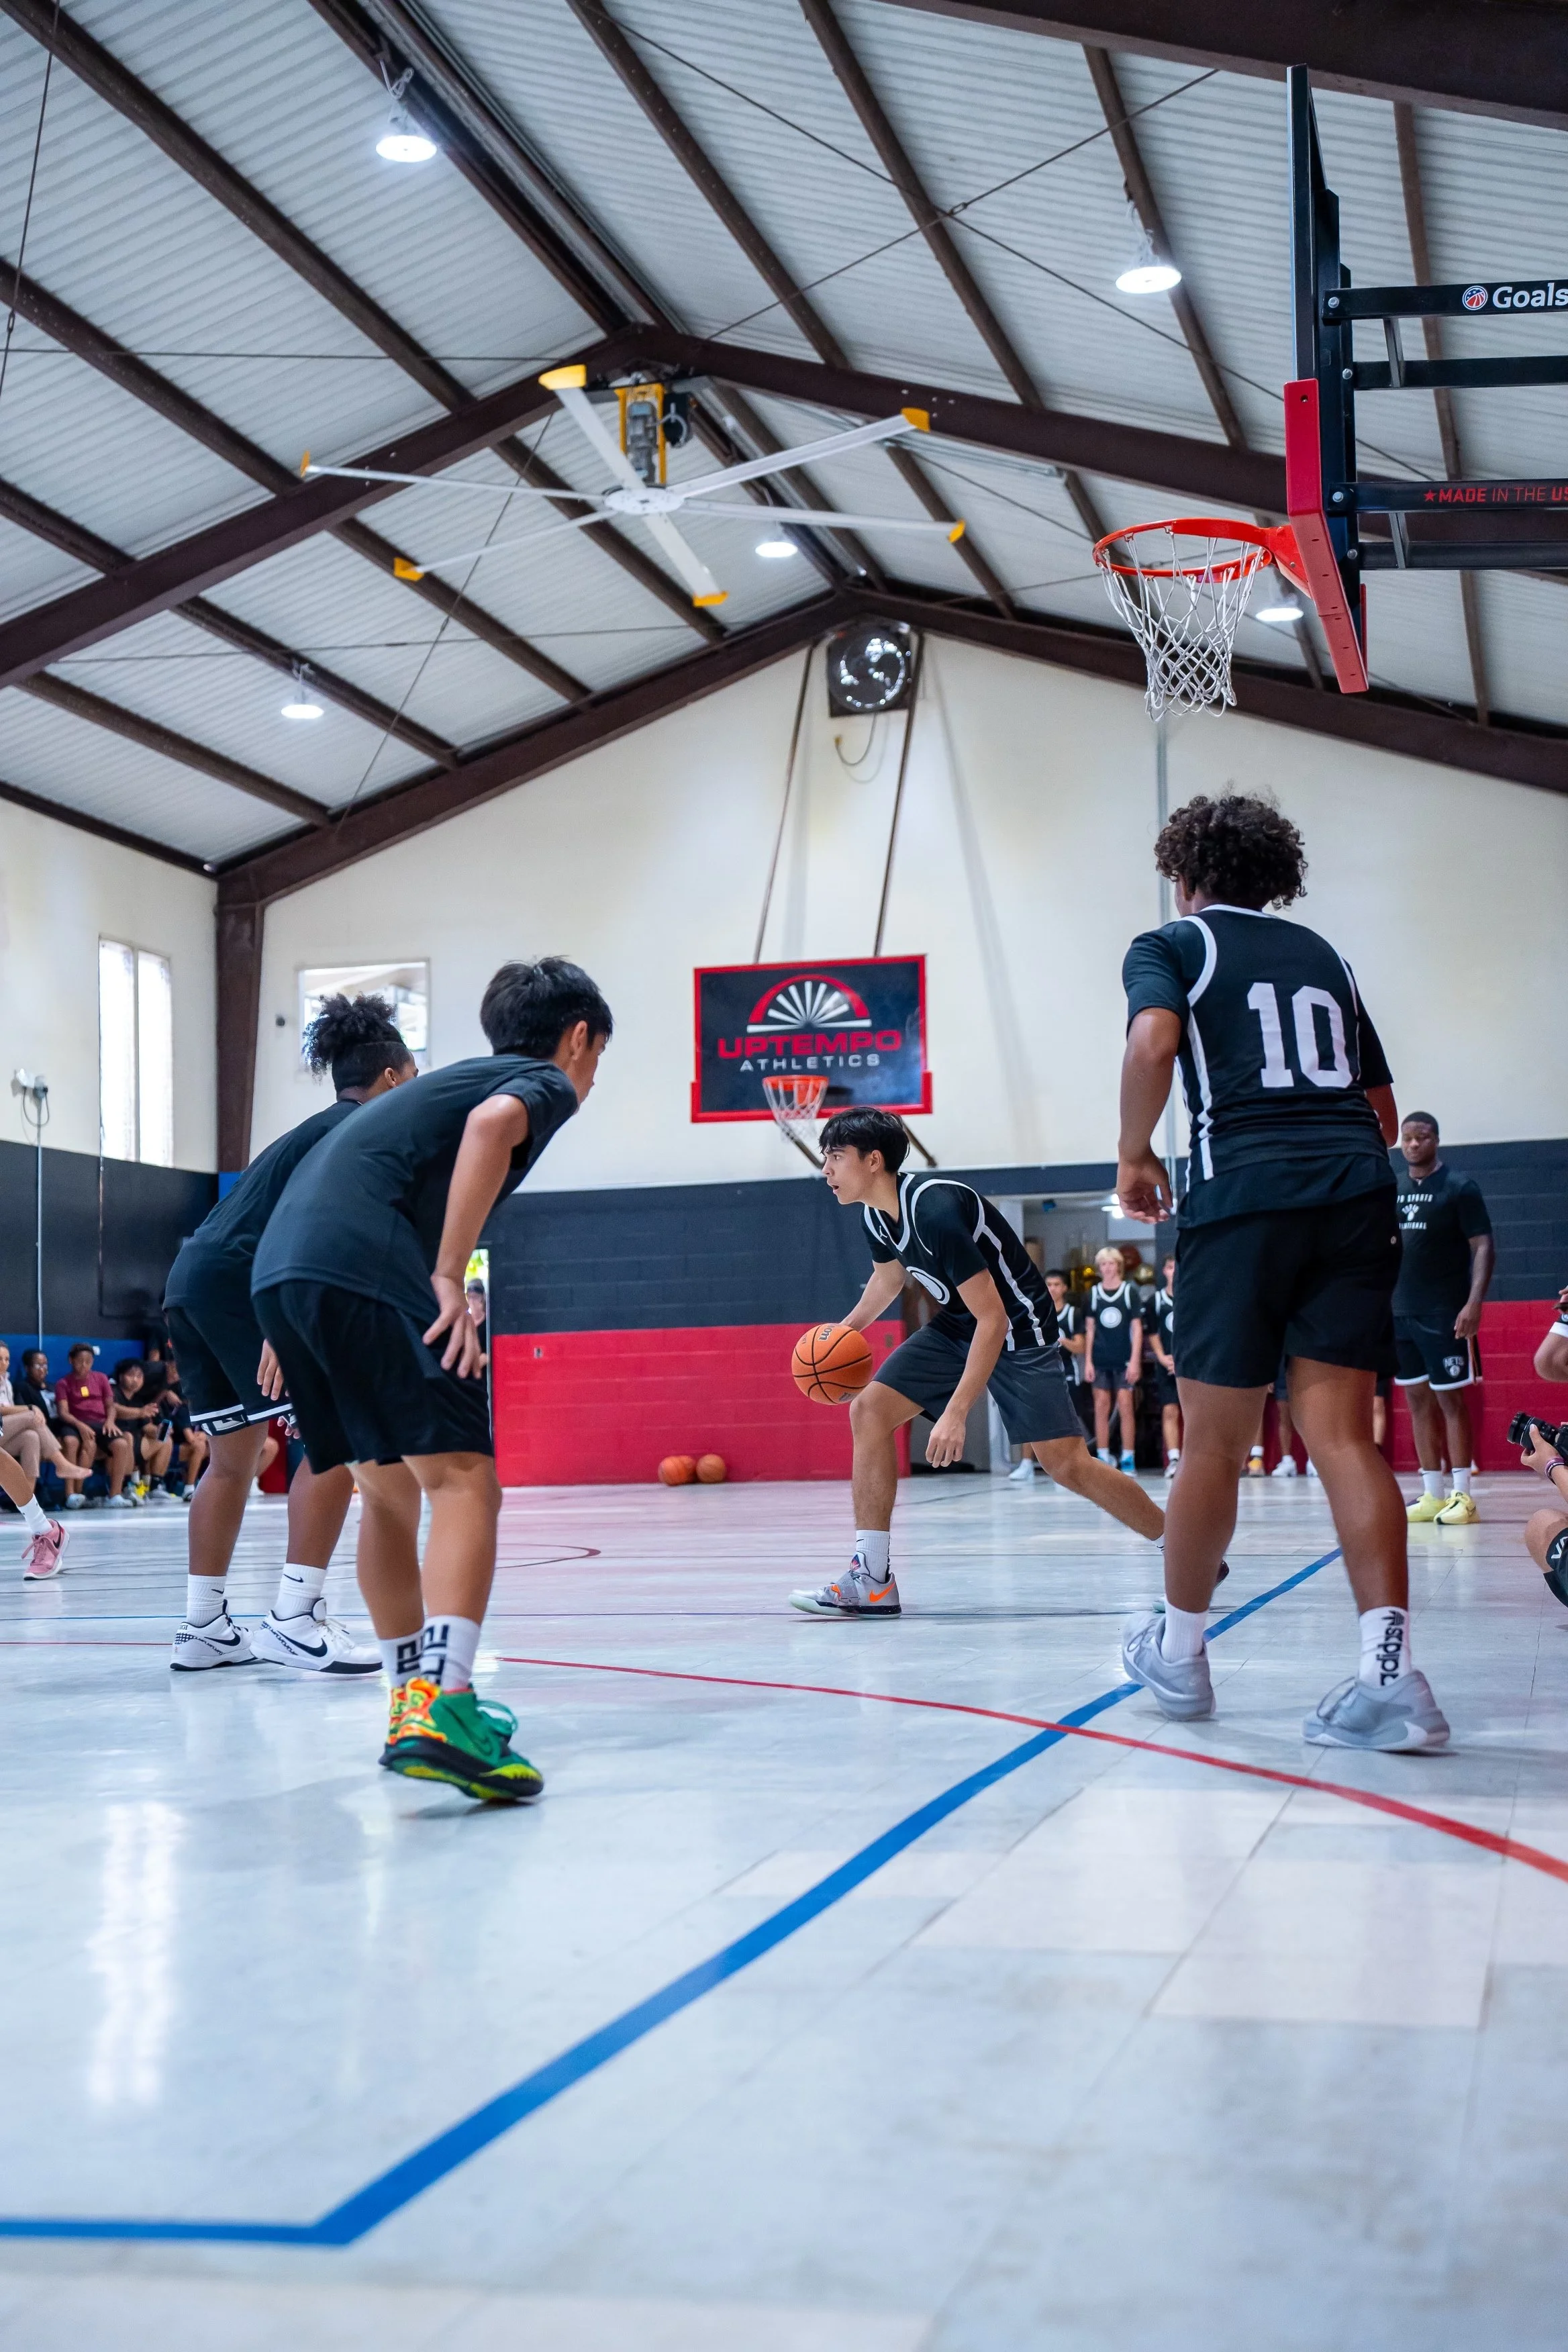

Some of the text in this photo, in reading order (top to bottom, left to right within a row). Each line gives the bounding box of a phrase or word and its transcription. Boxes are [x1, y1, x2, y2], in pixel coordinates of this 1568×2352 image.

[1492, 282, 1568, 308] Goals
[1438, 488, 1487, 503] MADE
[1492, 488, 1509, 502] IN
[1514, 487, 1547, 501] THE
[718, 1030, 902, 1059] UPTEMPO
[1246, 982, 1353, 1088] 10
[740, 1053, 881, 1073] ATHLETICS
